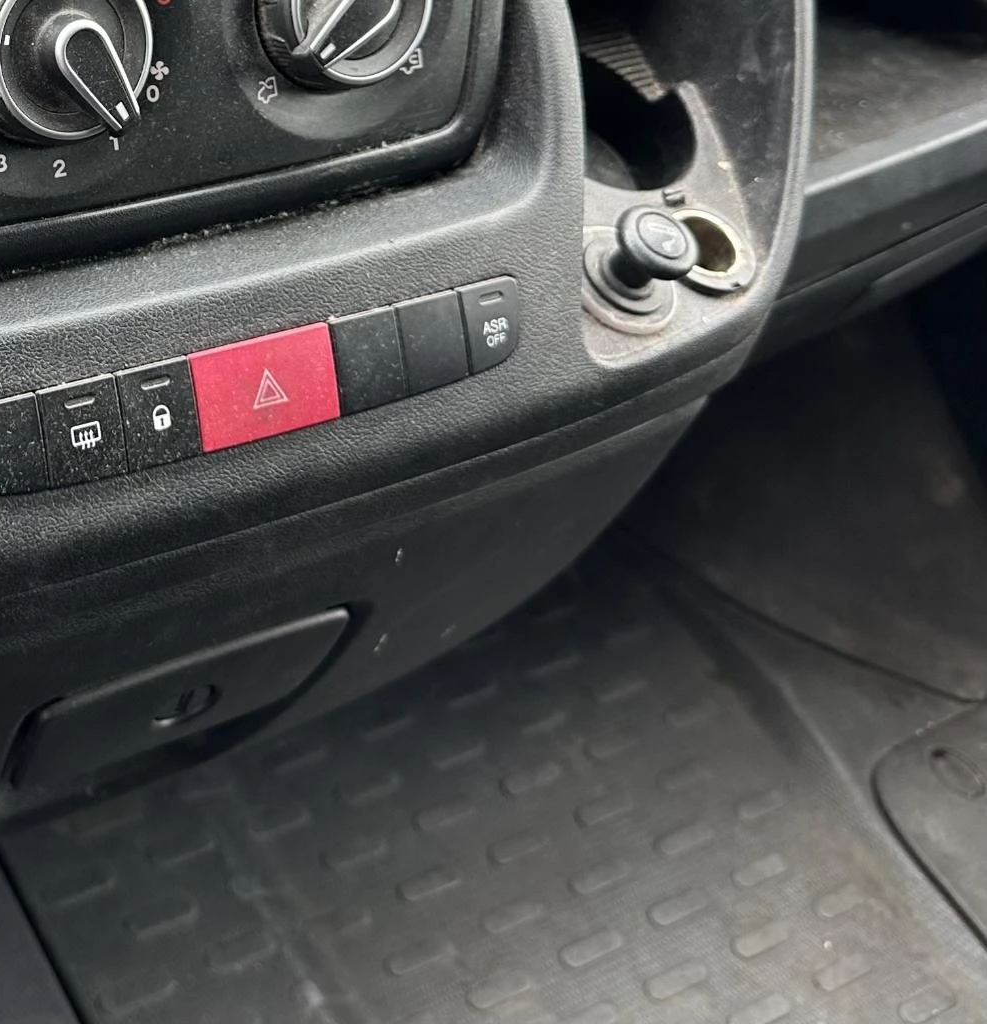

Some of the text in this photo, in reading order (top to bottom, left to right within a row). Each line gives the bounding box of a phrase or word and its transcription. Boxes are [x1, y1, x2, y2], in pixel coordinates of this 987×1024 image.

[145, 84, 160, 103] 0
[52, 159, 67, 178] 2
[483, 316, 510, 336] ASR
[486, 331, 508, 347] OFF
